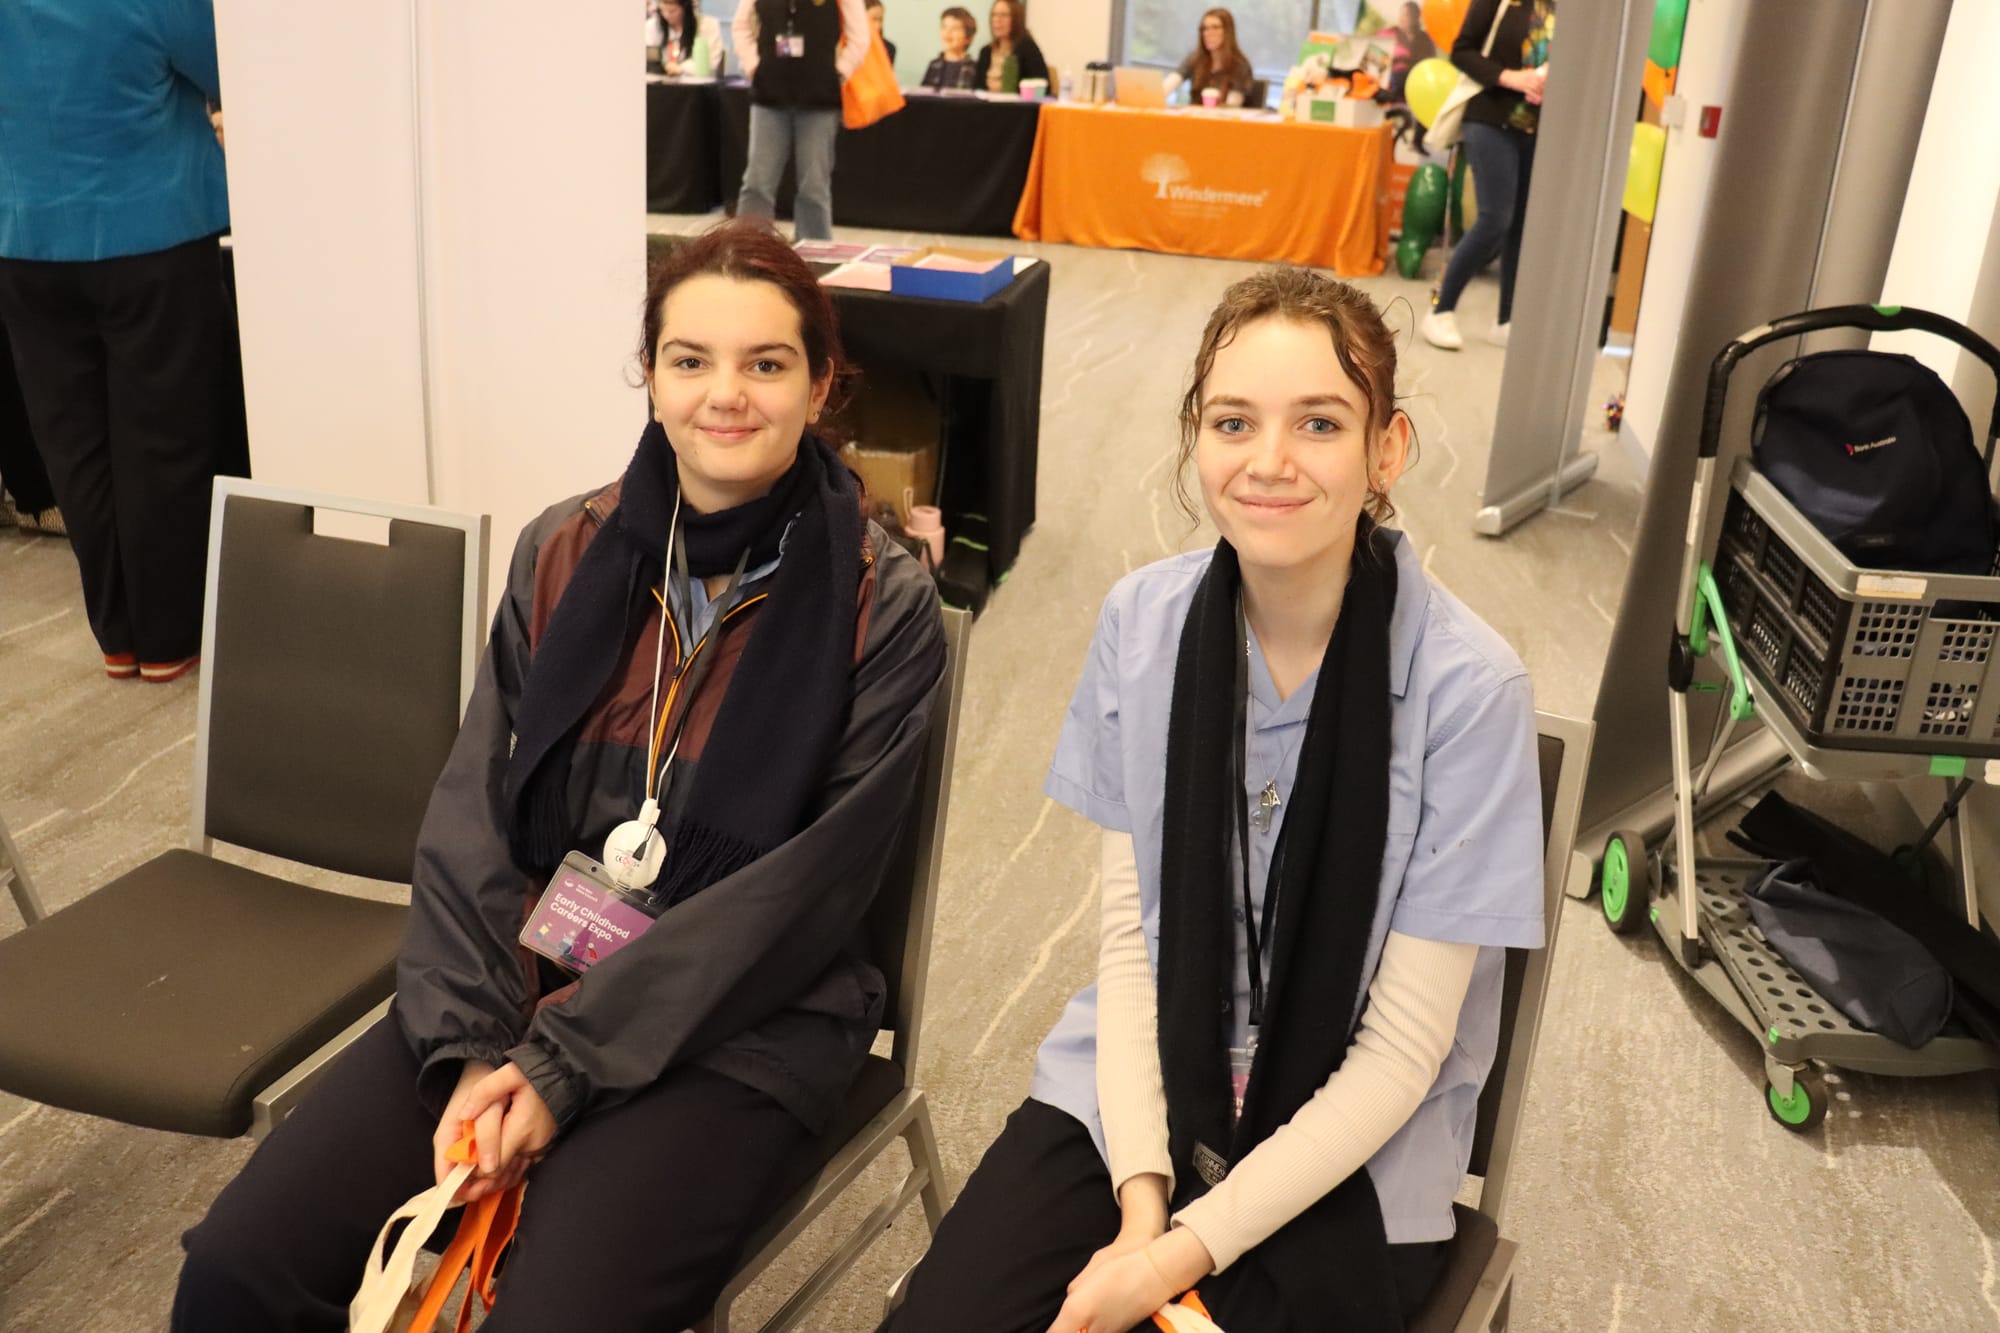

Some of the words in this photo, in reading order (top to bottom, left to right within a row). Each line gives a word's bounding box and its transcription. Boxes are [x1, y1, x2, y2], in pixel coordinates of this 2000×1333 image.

[1170, 186, 1264, 207] Windermere
[550, 902, 588, 928] Careers
[588, 922, 613, 942] Expo.
[554, 892, 580, 913] Early
[580, 907, 631, 939] Childhood
